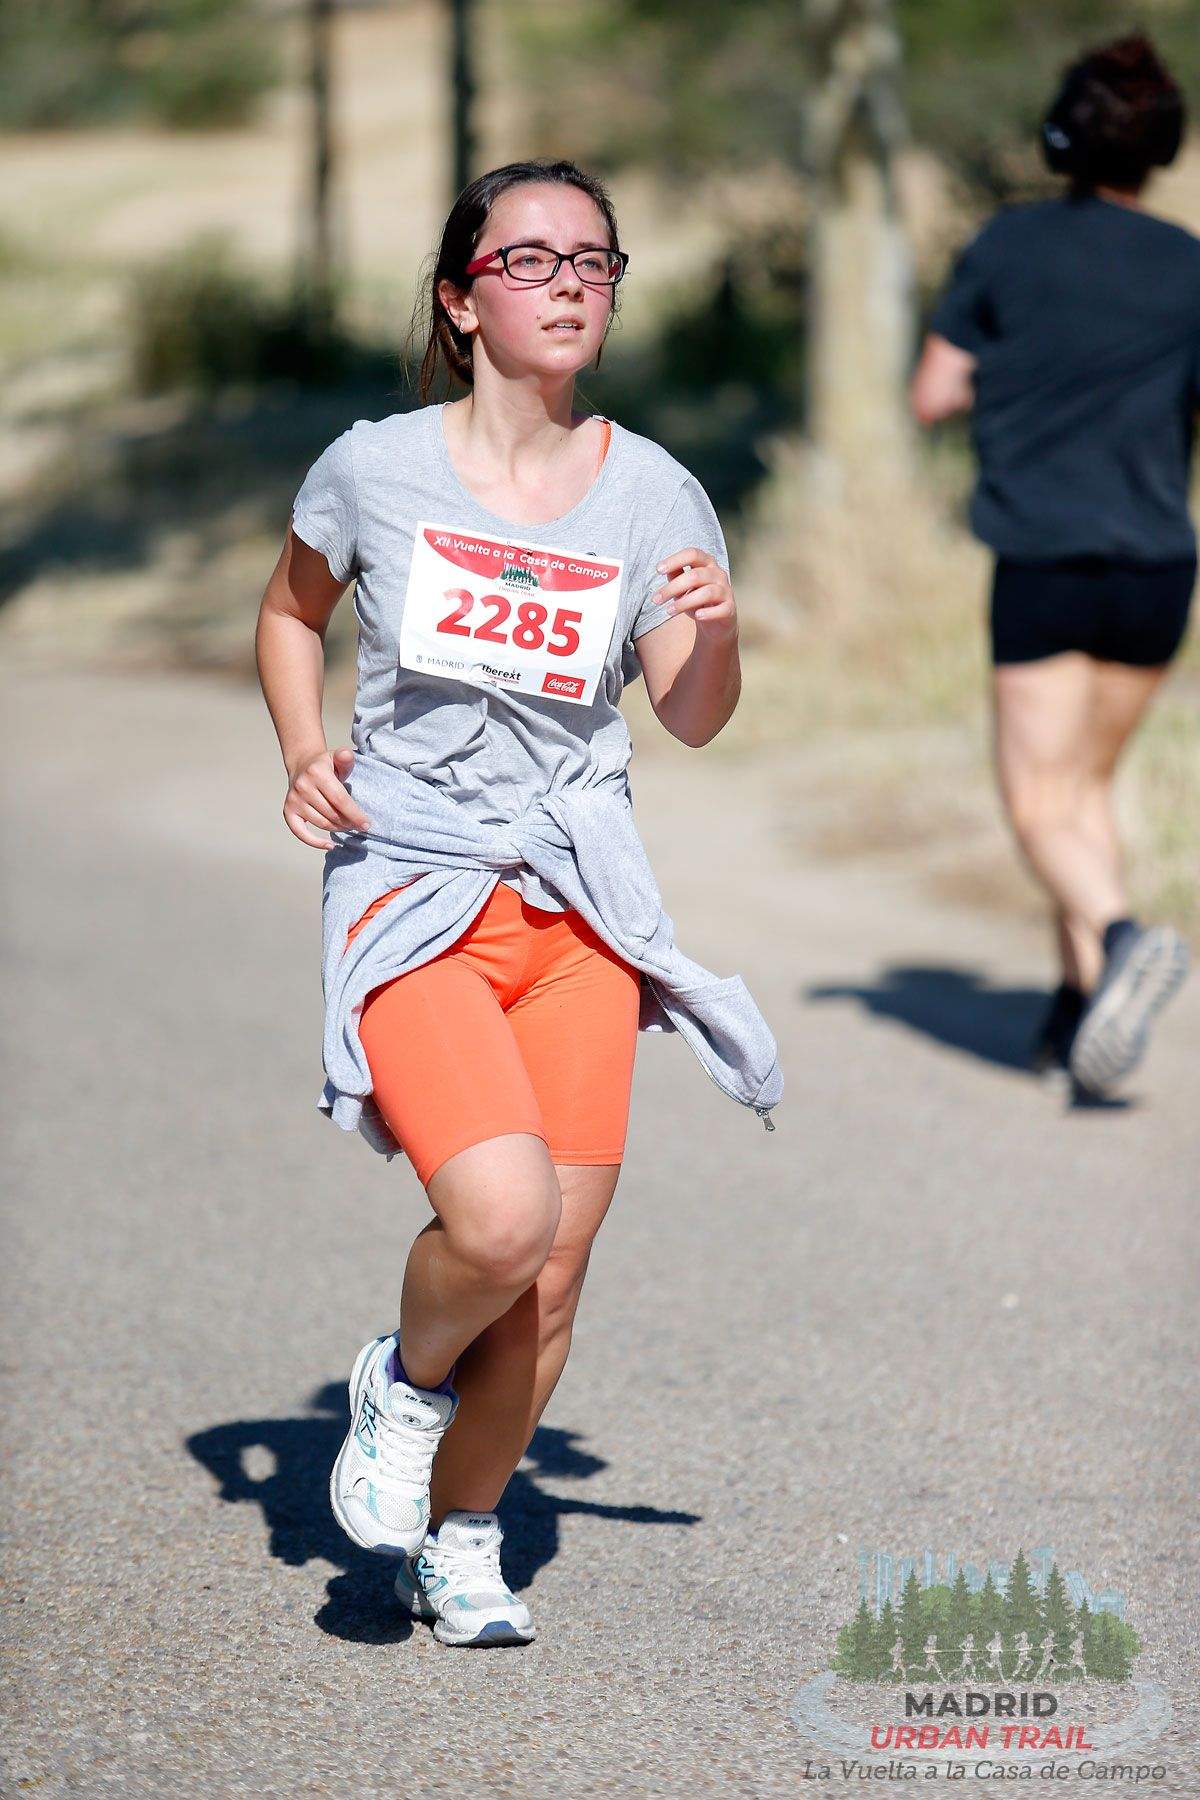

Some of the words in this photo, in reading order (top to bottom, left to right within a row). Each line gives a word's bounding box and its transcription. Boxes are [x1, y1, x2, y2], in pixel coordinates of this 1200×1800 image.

[453, 539, 490, 556] Vuelta
[492, 549, 501, 558] a
[503, 550, 515, 560] la
[519, 553, 548, 567] Casa
[550, 560, 565, 570] de
[567, 563, 609, 580] Campo
[436, 588, 583, 657] 2285
[427, 657, 465, 670] MADRID
